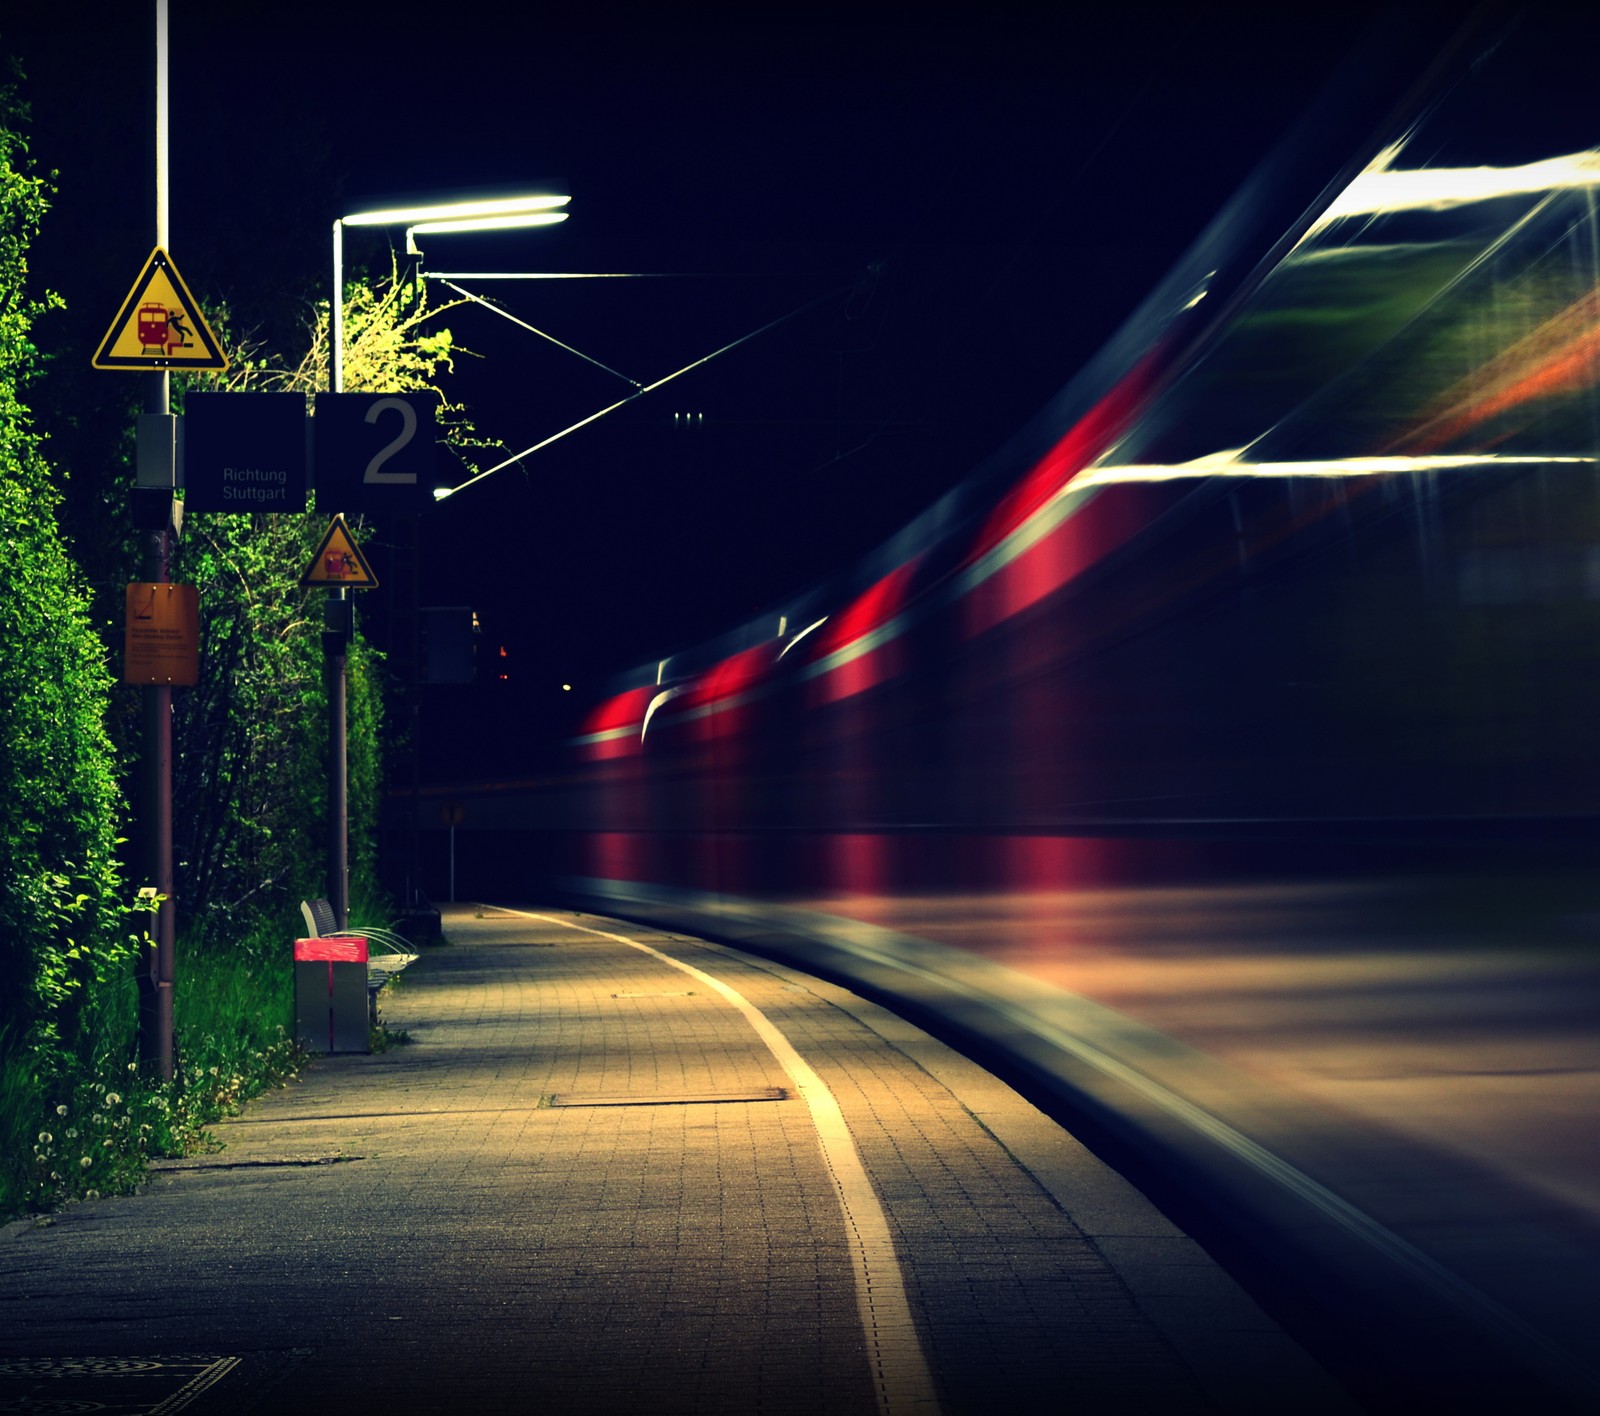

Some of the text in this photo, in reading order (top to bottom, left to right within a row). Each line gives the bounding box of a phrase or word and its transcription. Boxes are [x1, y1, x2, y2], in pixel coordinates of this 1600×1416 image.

[363, 397, 417, 484] 2
[223, 467, 287, 484] Richtung
[223, 486, 287, 501] Stuttgart
